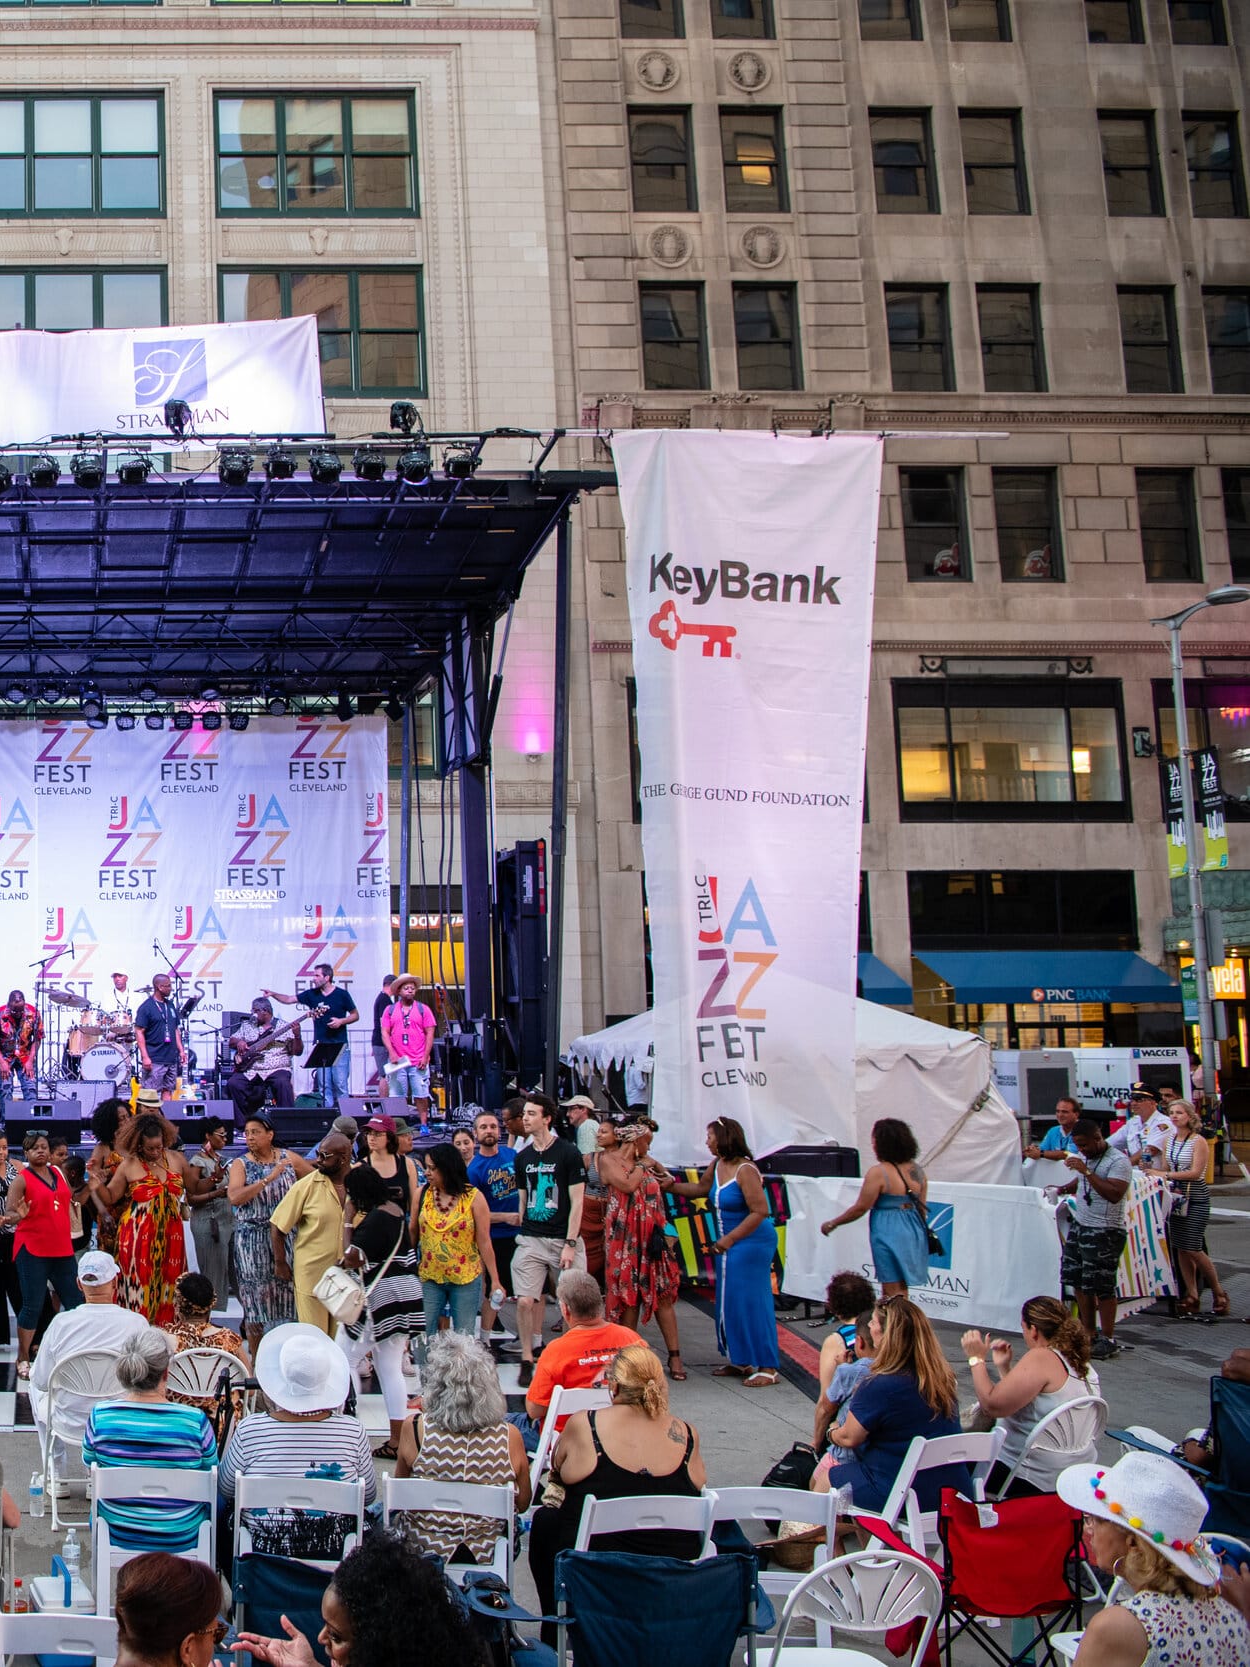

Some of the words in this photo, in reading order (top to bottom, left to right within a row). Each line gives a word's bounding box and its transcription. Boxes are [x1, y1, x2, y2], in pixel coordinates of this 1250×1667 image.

[116, 407, 229, 430] STRAMAN
[648, 552, 842, 606] KeyBank
[34, 765, 92, 783] FEST
[161, 762, 219, 781] FEST
[288, 761, 347, 780] FEST
[34, 786, 92, 795] CLEVELAND
[161, 784, 219, 794] CLEVELAND
[289, 783, 347, 792] CLEVELAND
[642, 783, 667, 799] THE
[704, 788, 748, 802] GUND
[751, 790, 850, 807] FOUNDATION
[110, 796, 119, 820] TRI-C
[238, 794, 247, 818] TRI-C
[98, 869, 157, 888] FEST
[227, 868, 286, 887] FEST
[99, 891, 157, 901] CLEVELAND
[214, 889, 278, 900] STRASSMAN
[357, 889, 390, 899] CLEVE
[695, 874, 713, 923] TRI-C
[46, 906, 54, 930] TRI-C
[174, 905, 183, 930] TRI-C
[1046, 989, 1075, 1000] PNC
[1076, 989, 1111, 1000] BANK
[1141, 1049, 1178, 1057] WACKER
[918, 1292, 959, 1308] Services
